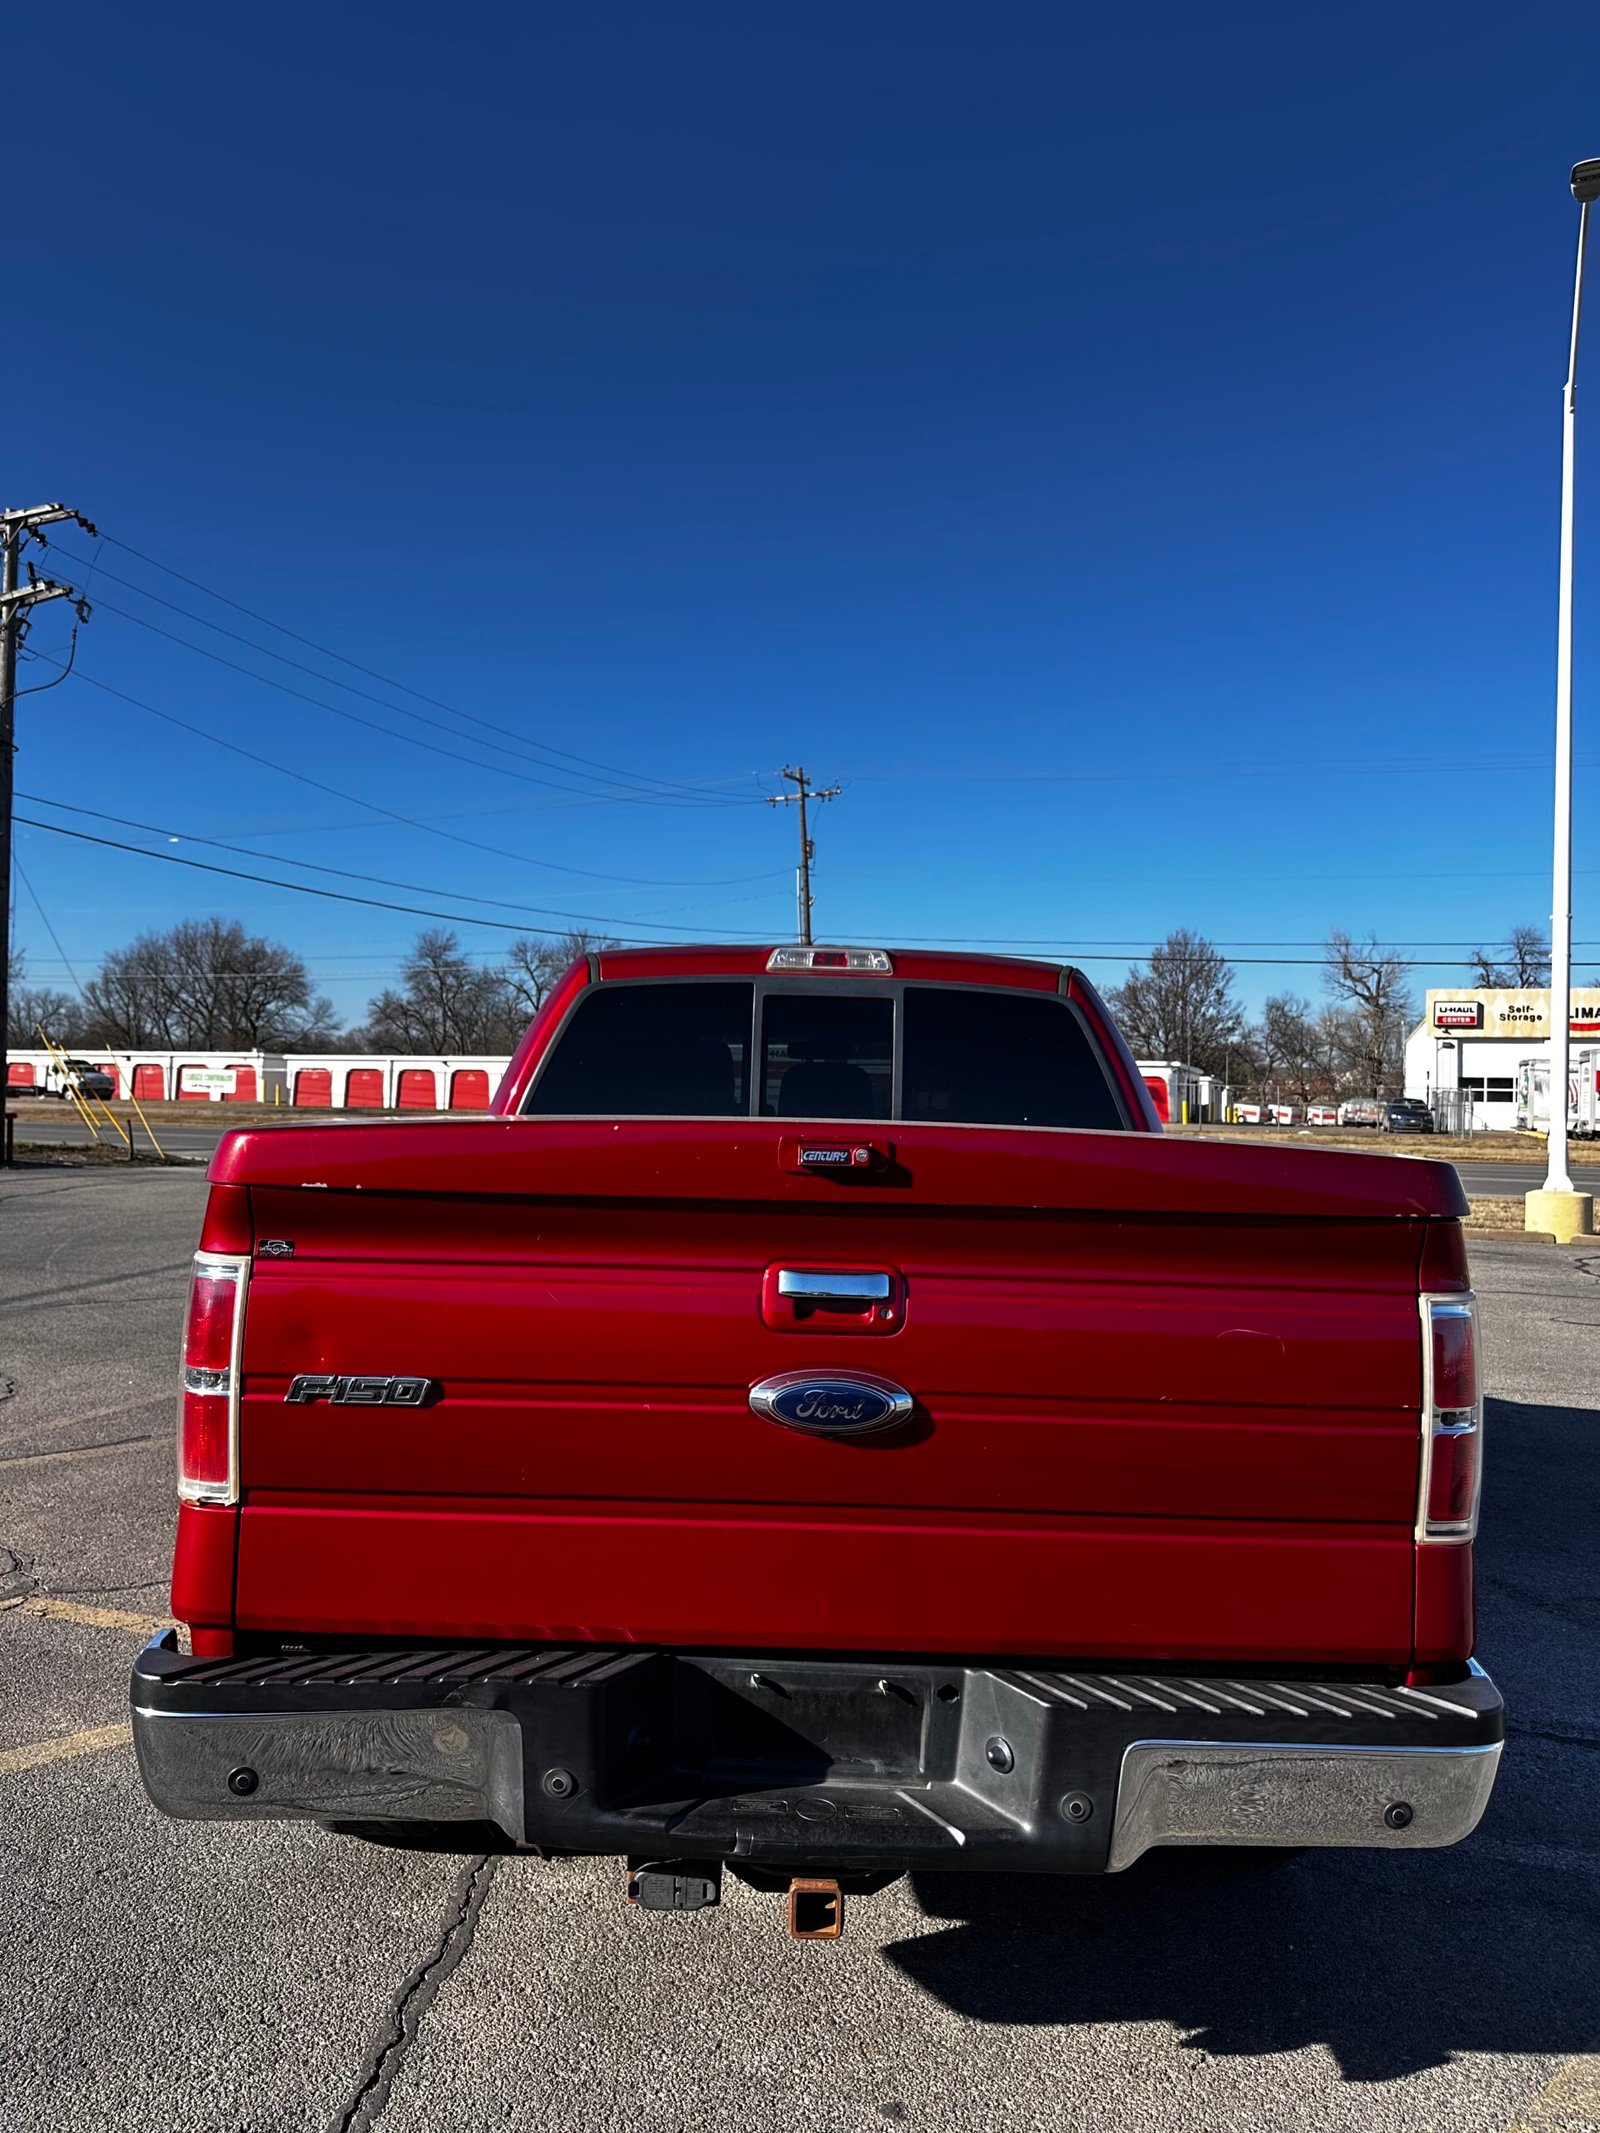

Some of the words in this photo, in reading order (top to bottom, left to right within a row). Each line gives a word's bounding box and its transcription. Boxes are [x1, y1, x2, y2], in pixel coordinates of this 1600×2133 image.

[1508, 1005, 1534, 1013] Self-
[1442, 1016, 1471, 1024] CENTER
[1499, 1013, 1543, 1023] Storage
[803, 1150, 848, 1162] CENTURY
[796, 1389, 864, 1420] Ford
